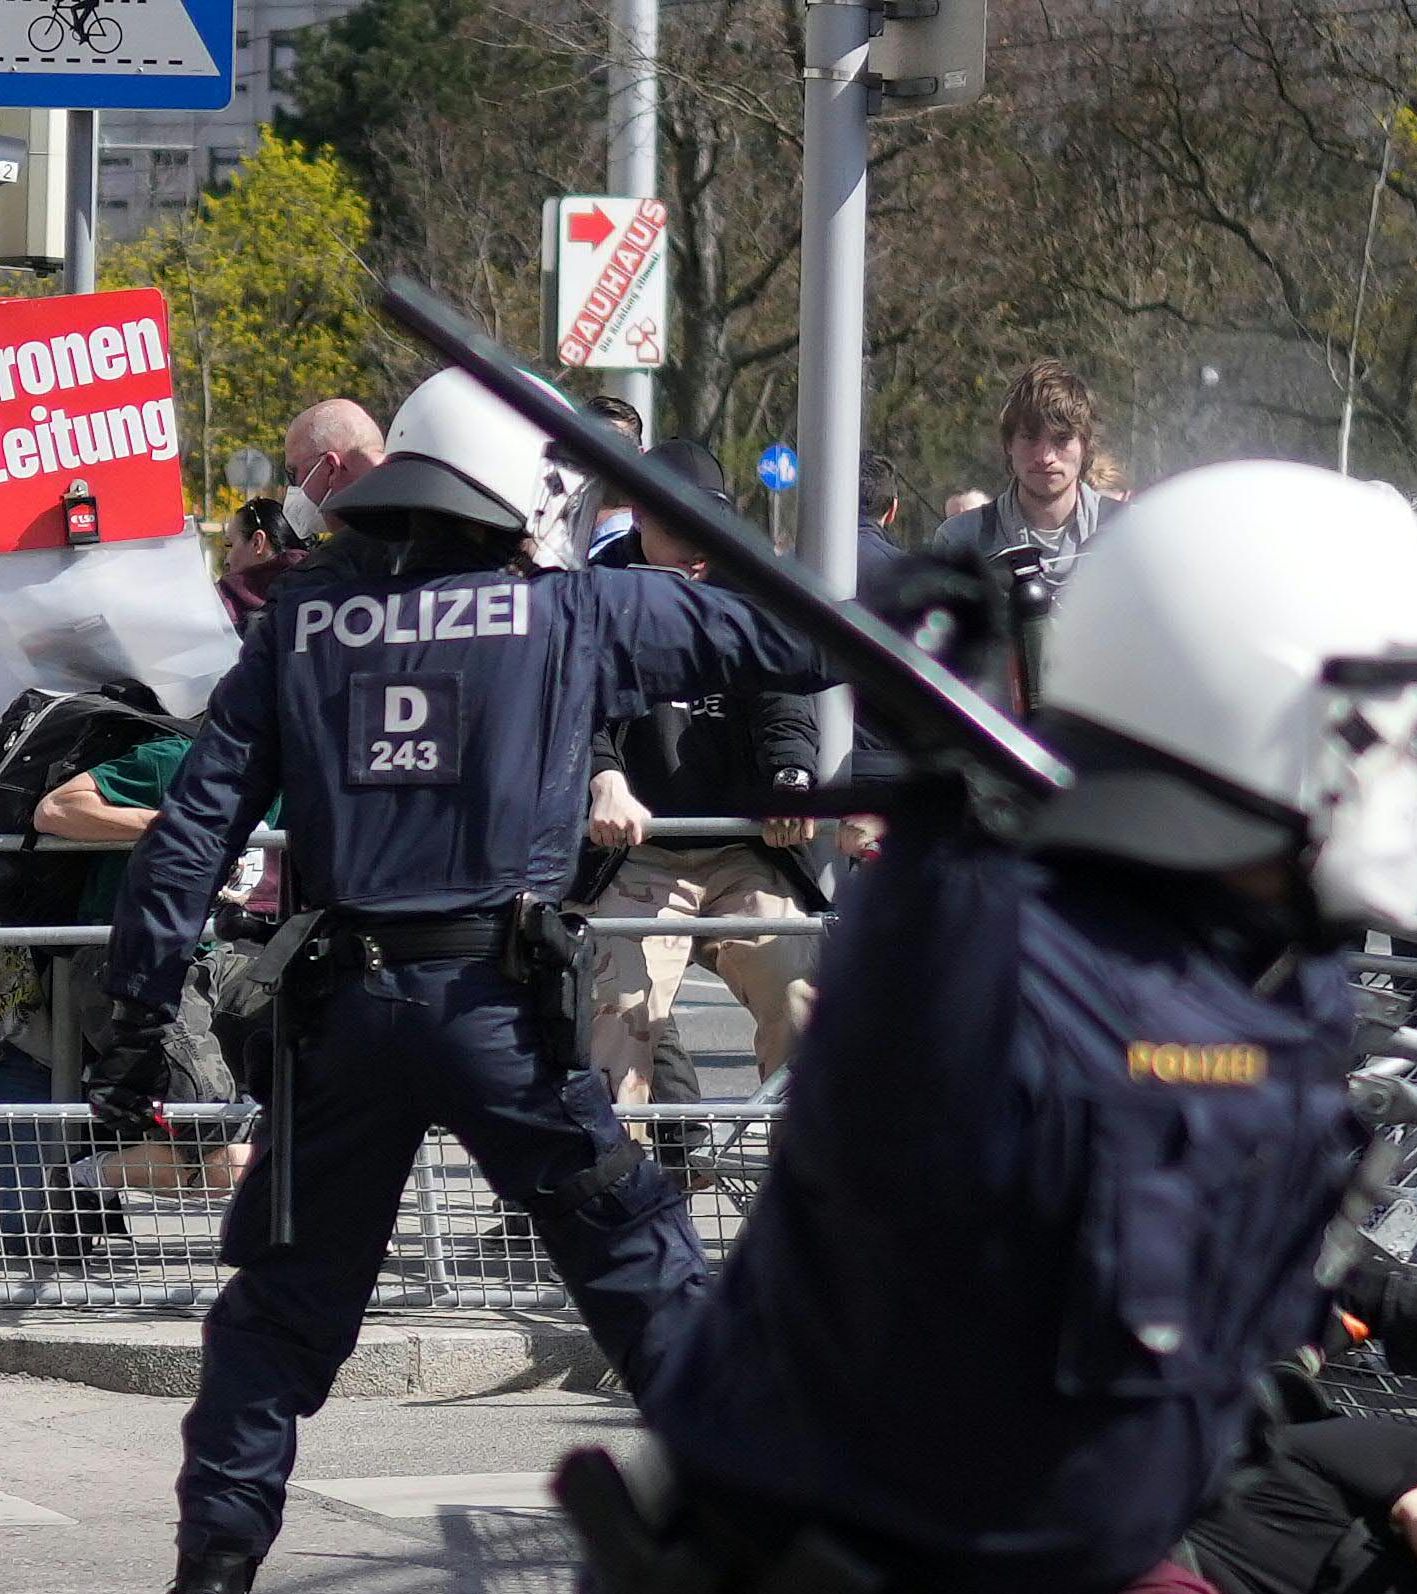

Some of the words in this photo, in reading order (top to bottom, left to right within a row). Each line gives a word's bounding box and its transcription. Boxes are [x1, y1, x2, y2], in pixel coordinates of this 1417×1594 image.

[560, 199, 668, 368] BAUHAUS
[0, 398, 178, 483] eitung
[294, 583, 528, 653] POLIZEI
[384, 685, 428, 732] D
[370, 740, 438, 771] 243
[1128, 1040, 1268, 1084] POLIZEI
